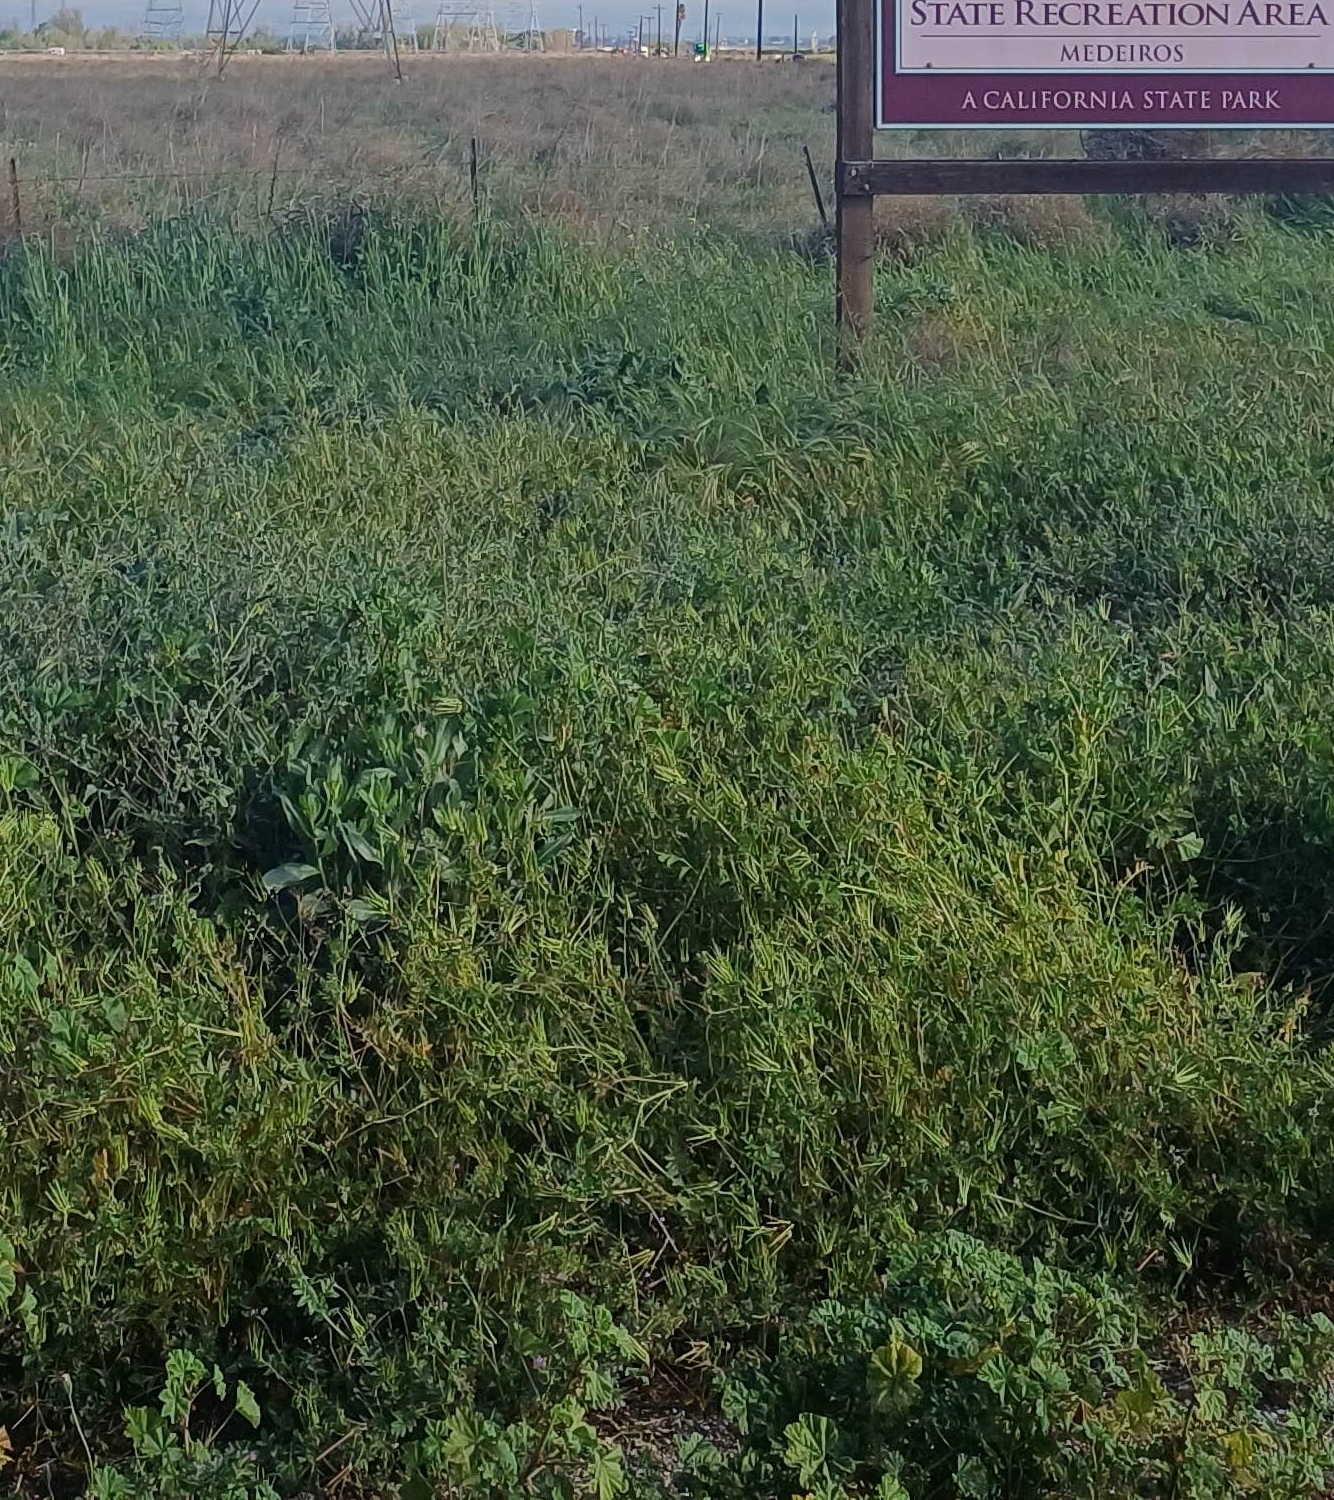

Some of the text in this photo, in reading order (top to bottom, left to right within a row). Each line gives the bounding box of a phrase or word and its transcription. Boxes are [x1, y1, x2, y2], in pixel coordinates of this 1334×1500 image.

[910, 0, 1331, 26] STATE RECREATION AREA
[1060, 44, 1184, 62] MEDEIROS
[962, 91, 1282, 109] A CALIFORNIA STATE PARK
